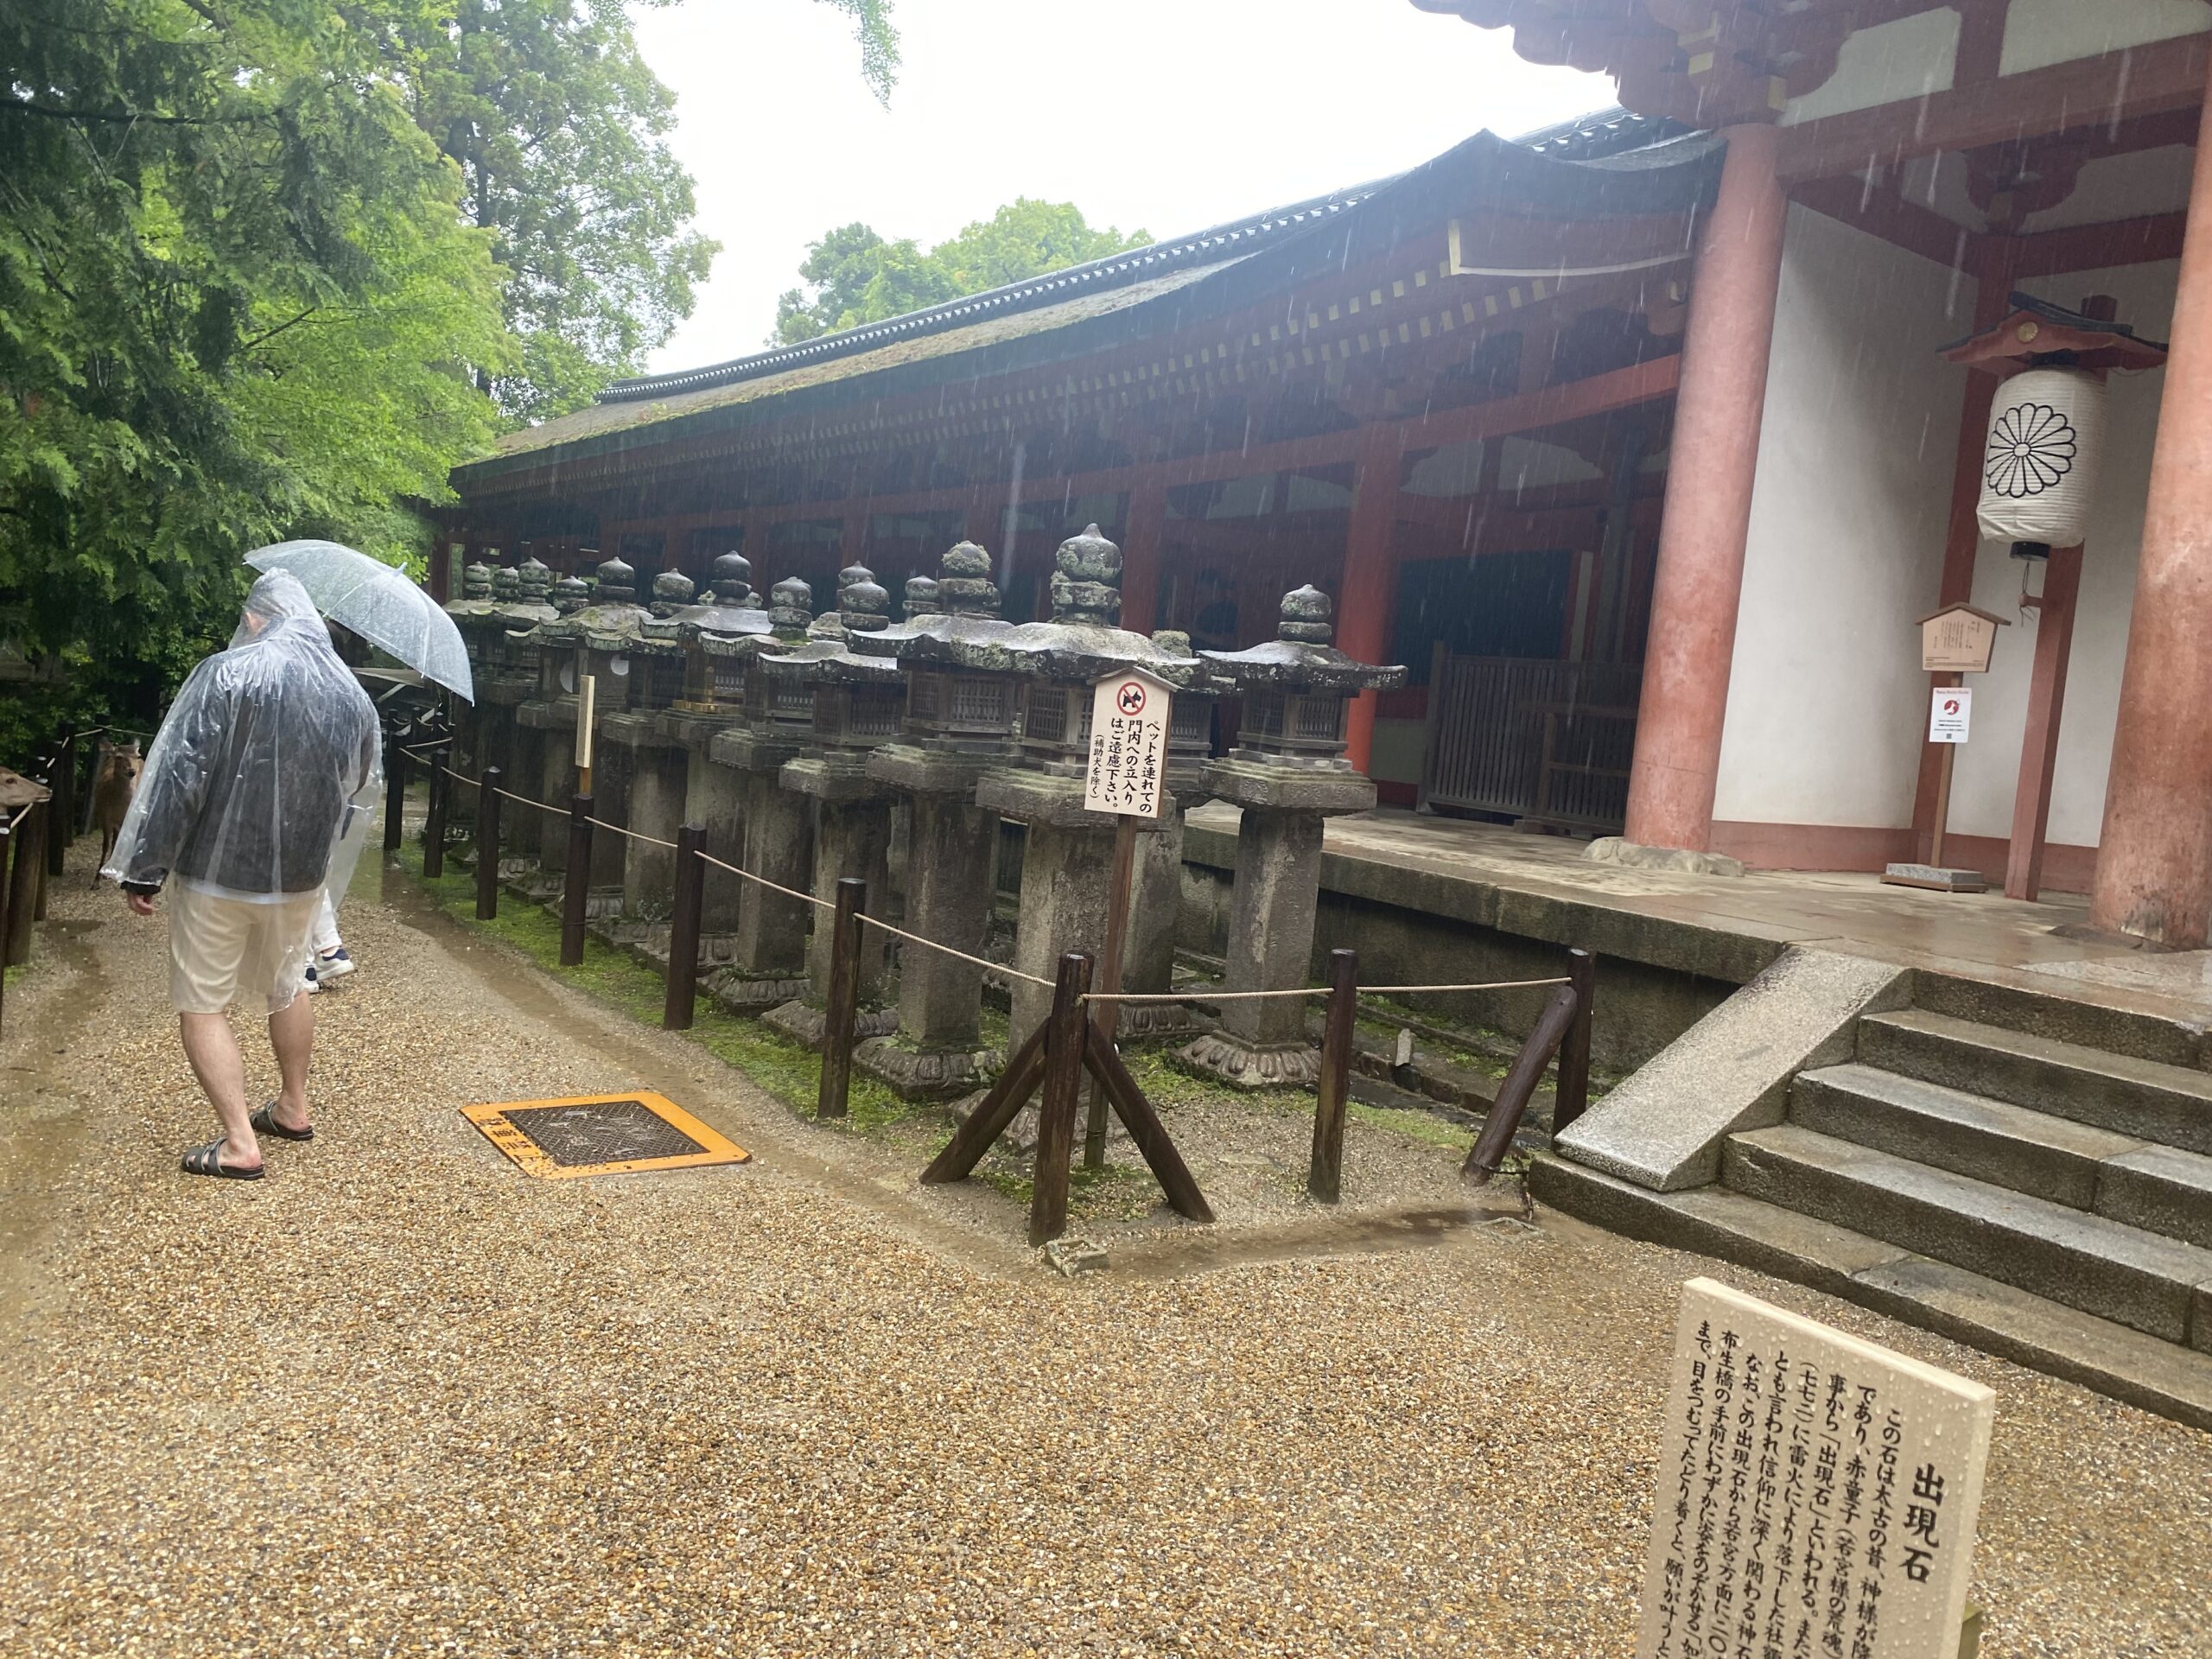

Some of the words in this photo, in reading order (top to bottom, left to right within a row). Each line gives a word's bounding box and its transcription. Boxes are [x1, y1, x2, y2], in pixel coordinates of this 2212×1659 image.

[1105, 717, 1124, 808] はご遠慮下さい。
[1122, 720, 1142, 805] 門内への立入り
[1140, 721, 1160, 813] ペットを連れての
[1792, 1373, 1847, 1659] 事から「出現石」といわれる。また
[1898, 1463, 1945, 1584] 出現石
